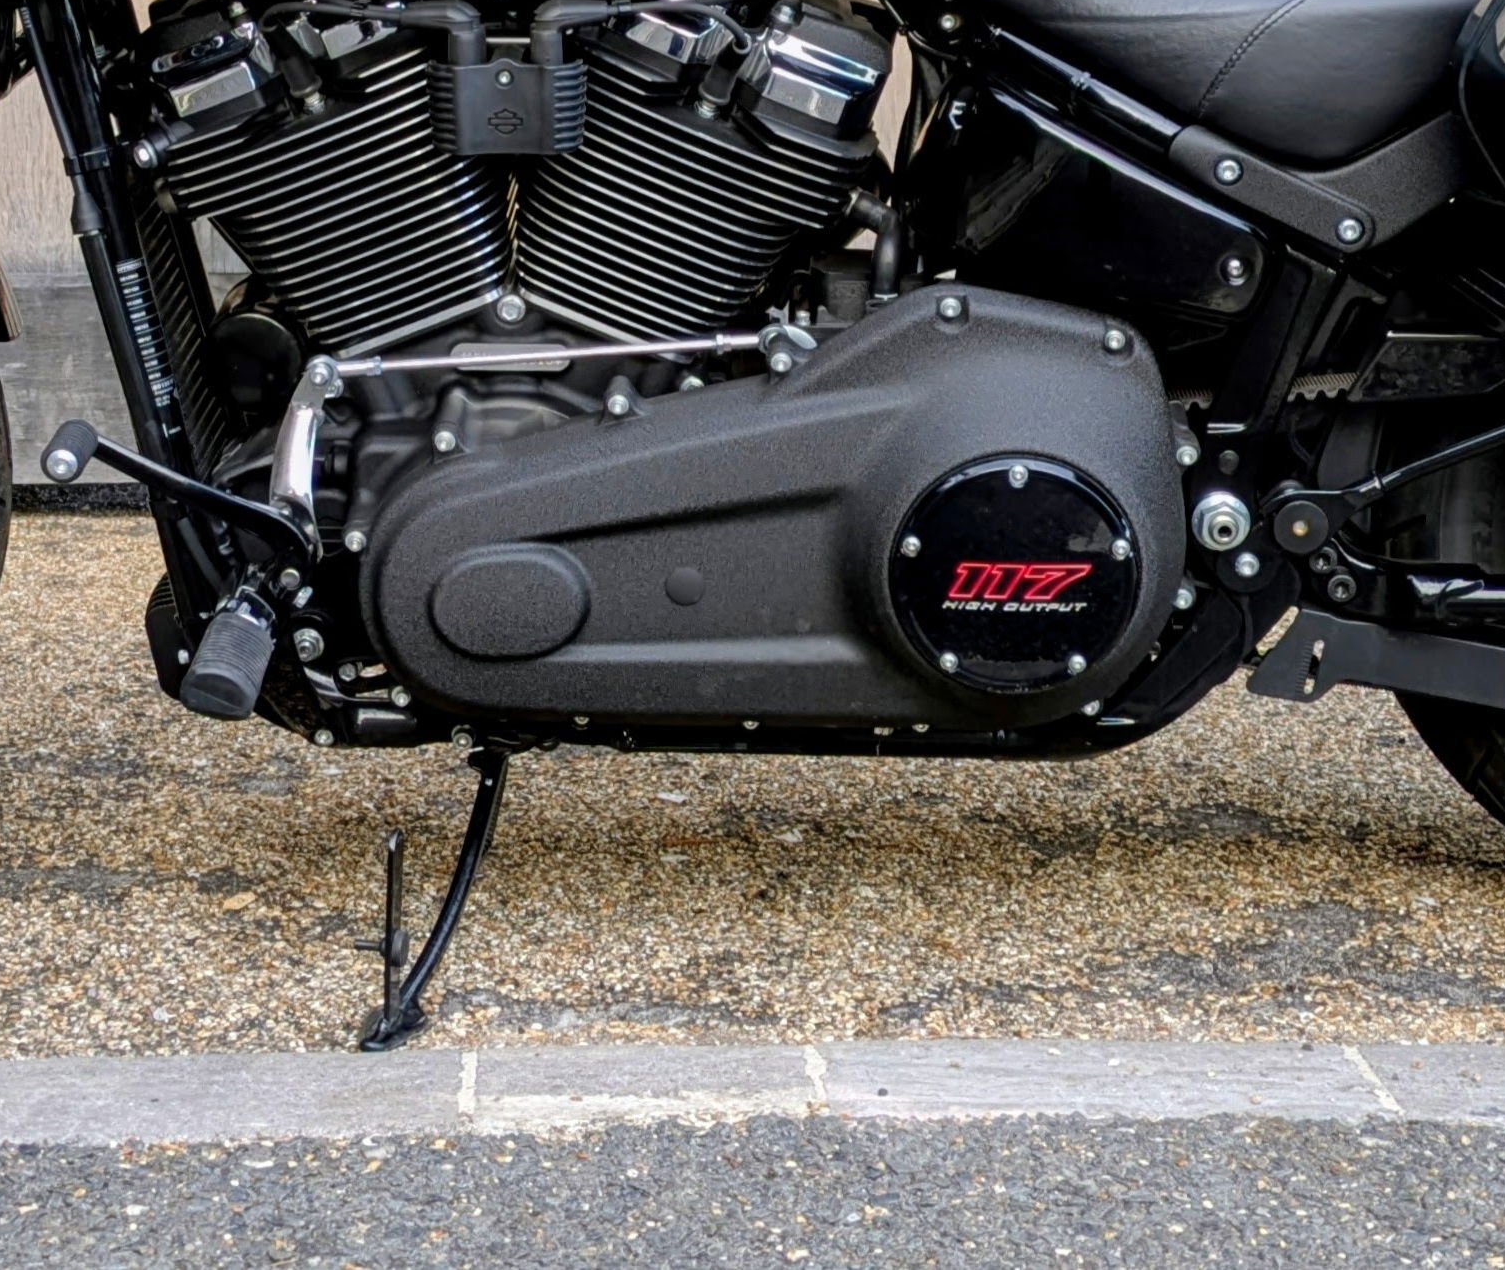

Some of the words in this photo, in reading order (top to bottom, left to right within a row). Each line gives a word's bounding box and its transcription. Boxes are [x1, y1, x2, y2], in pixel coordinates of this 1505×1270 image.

[947, 561, 1094, 601] 117
[942, 600, 997, 612] HIGH
[1003, 602, 1088, 613] OUTPUT
